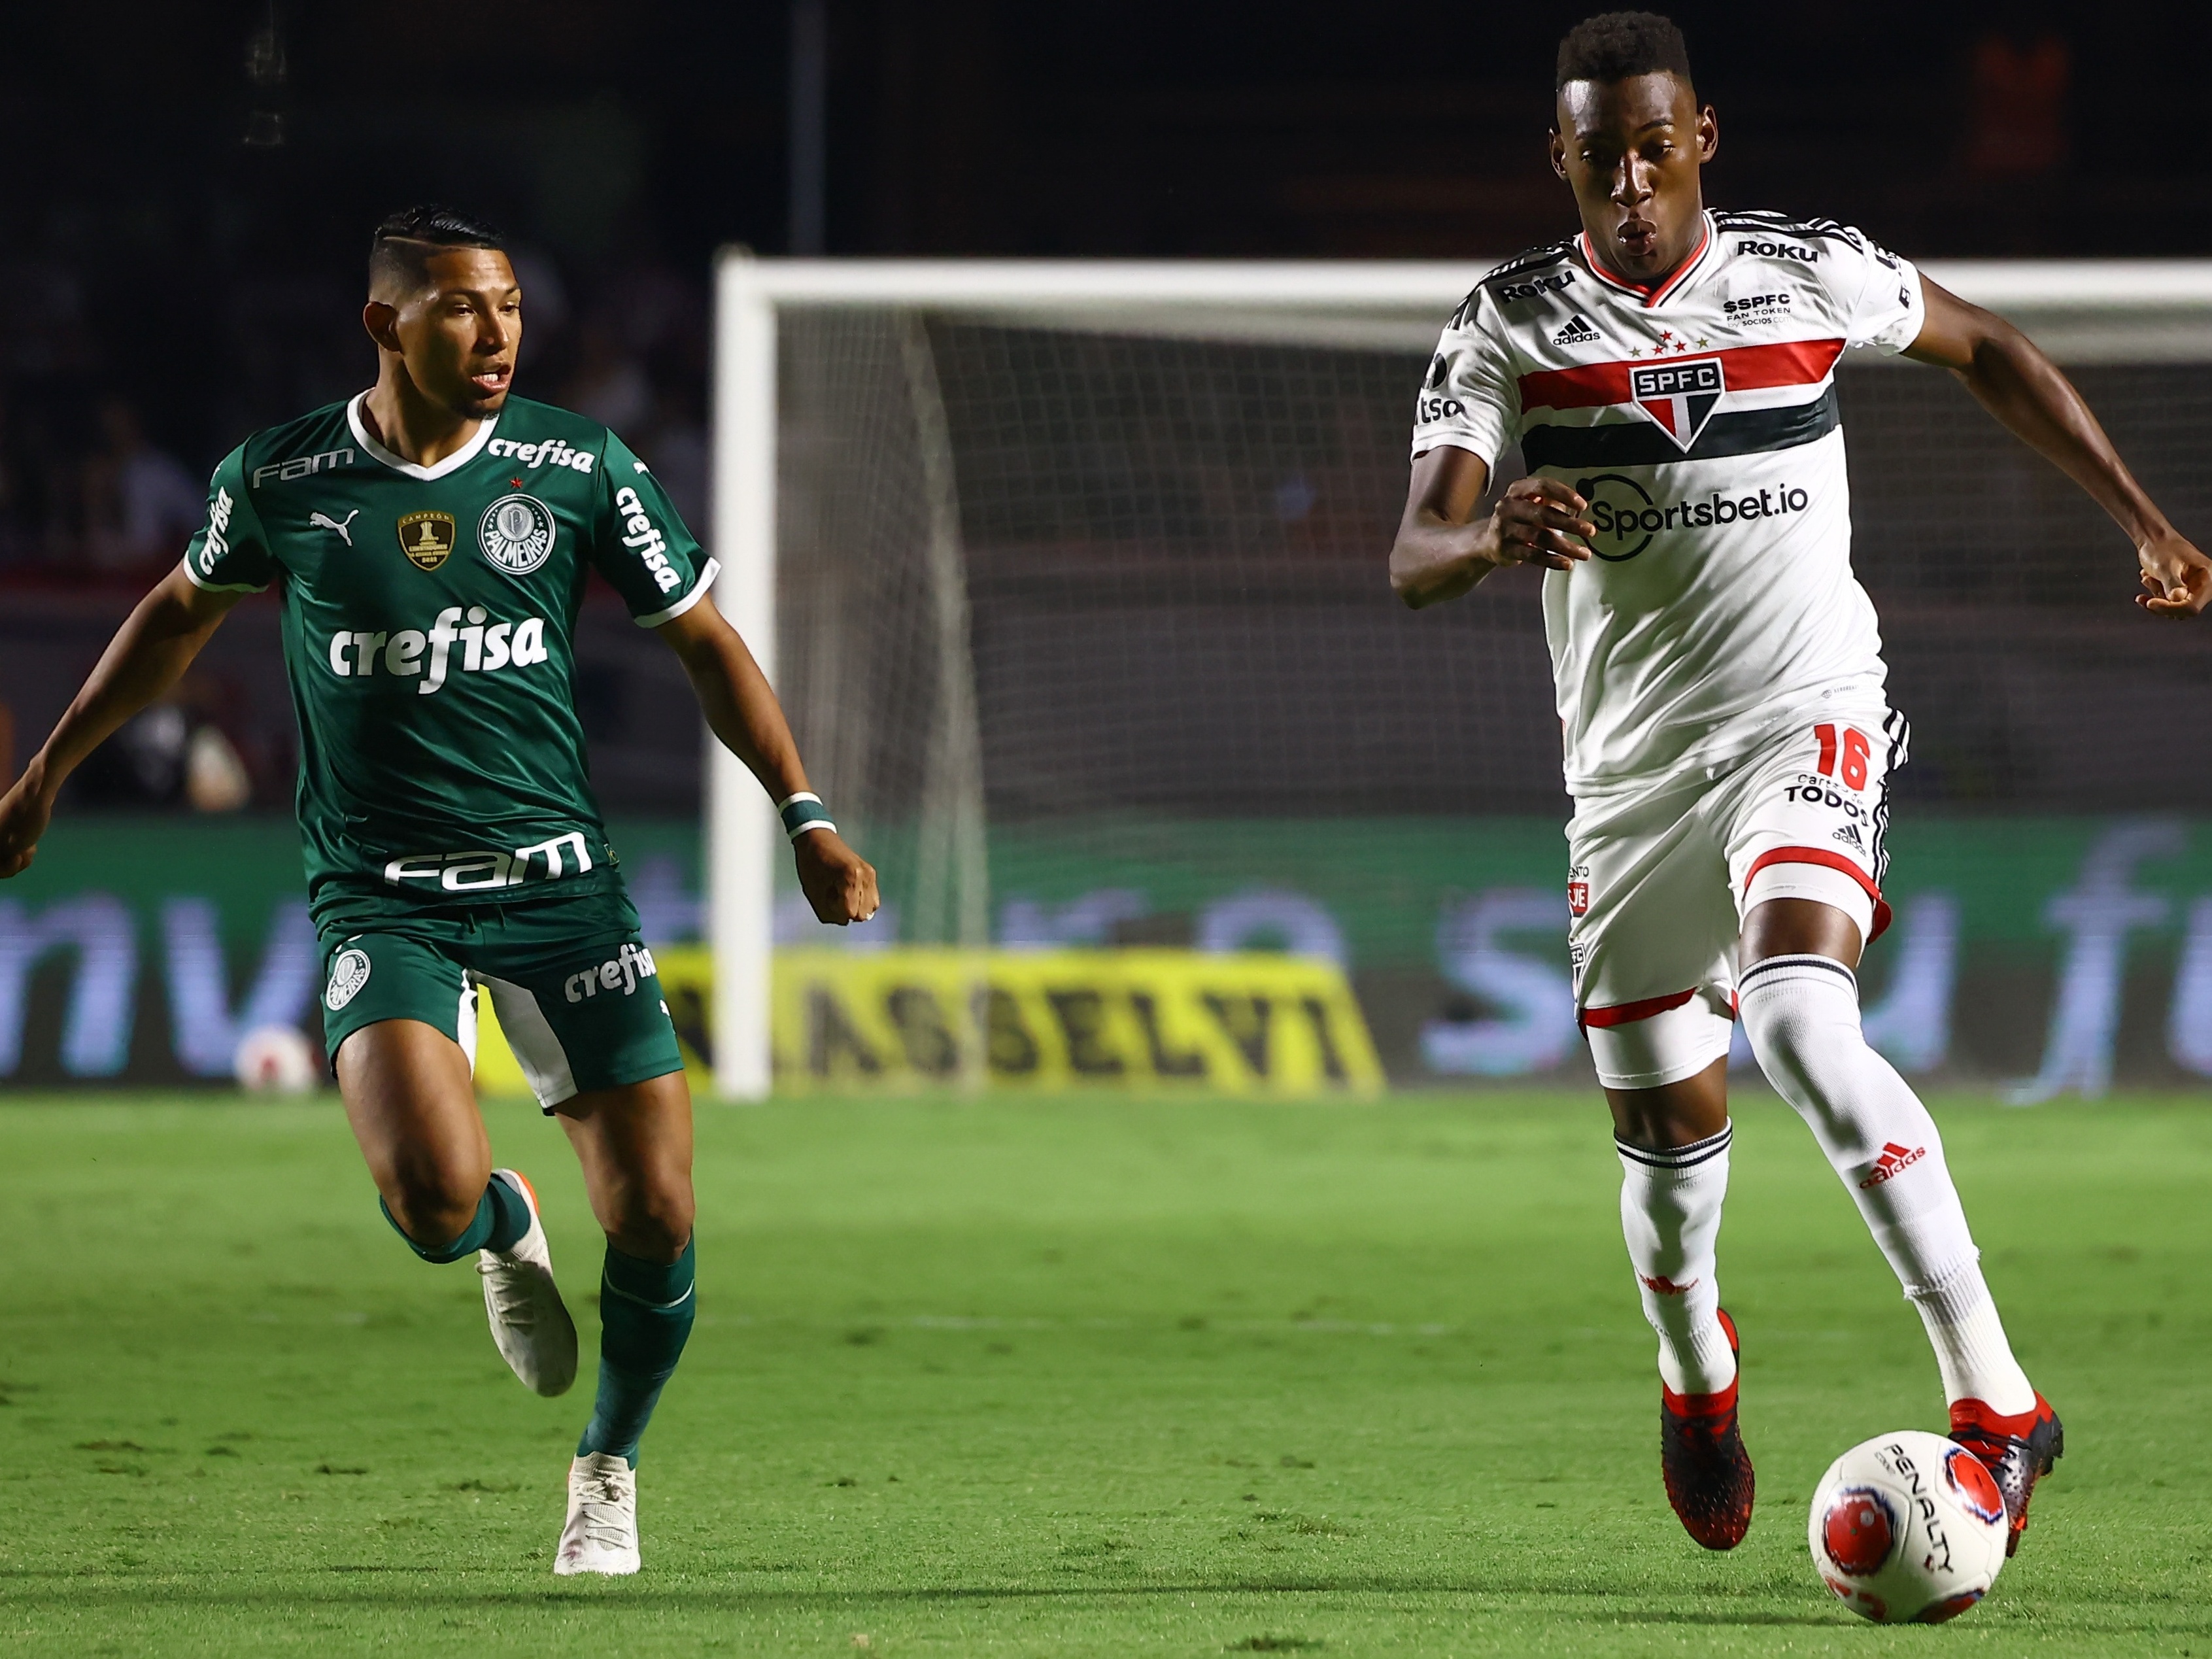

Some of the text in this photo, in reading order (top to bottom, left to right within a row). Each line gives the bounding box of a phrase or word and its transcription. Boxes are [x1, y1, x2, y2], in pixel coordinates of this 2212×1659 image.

[1724, 294, 1790, 313] $SPFC
[1727, 313, 1749, 321] FAN
[1553, 332, 1601, 345] adidas
[1639, 368, 1715, 392] SPFC
[1415, 397, 1462, 426] tso
[488, 438, 596, 473] crefisa
[199, 486, 233, 575] crefisa
[1591, 483, 1809, 541] Sportsbet.io
[485, 528, 548, 567] PALMEIRAS
[616, 487, 681, 594] crefisa
[330, 606, 548, 694] crefisa
[1814, 724, 1871, 792] 16
[1784, 785, 1869, 827] TODOS
[565, 943, 657, 1003] crefis
[1860, 1146, 1926, 1189] adidas
[1883, 1443, 1954, 1575] PENALTY
